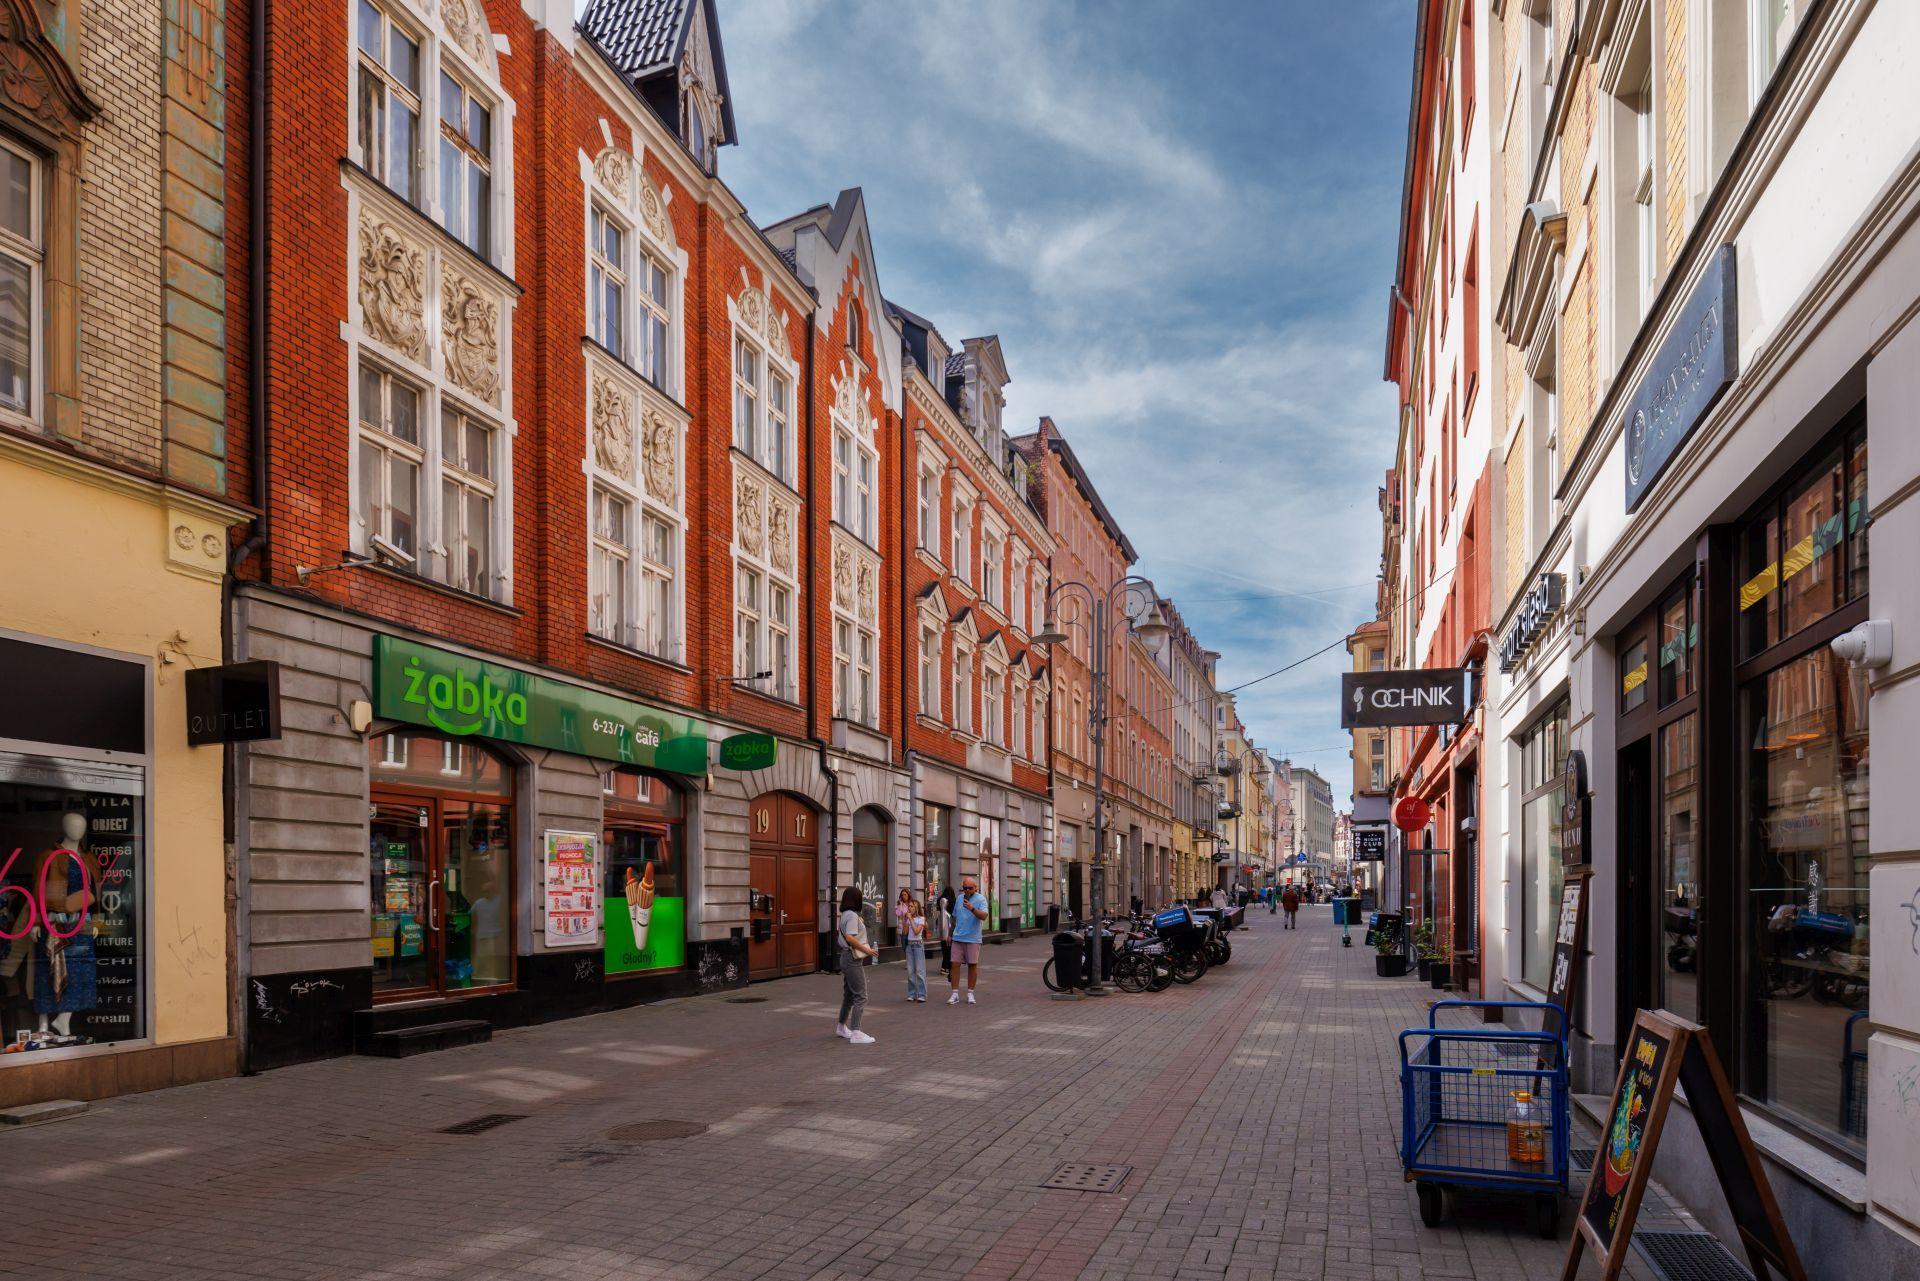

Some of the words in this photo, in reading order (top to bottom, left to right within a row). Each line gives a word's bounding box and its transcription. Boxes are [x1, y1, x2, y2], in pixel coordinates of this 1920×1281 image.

[404, 656, 527, 726] żabka
[1371, 686, 1453, 708] OCHNIK
[593, 718, 625, 737] 6-23/7
[725, 741, 769, 757] żabka
[89, 797, 131, 807] VILA
[92, 818, 128, 831] OBJECT
[756, 809, 769, 833] 19
[796, 814, 807, 837] 17
[1563, 827, 1581, 848] MENU
[91, 844, 131, 855] fransa
[87, 1012, 130, 1024] cream
